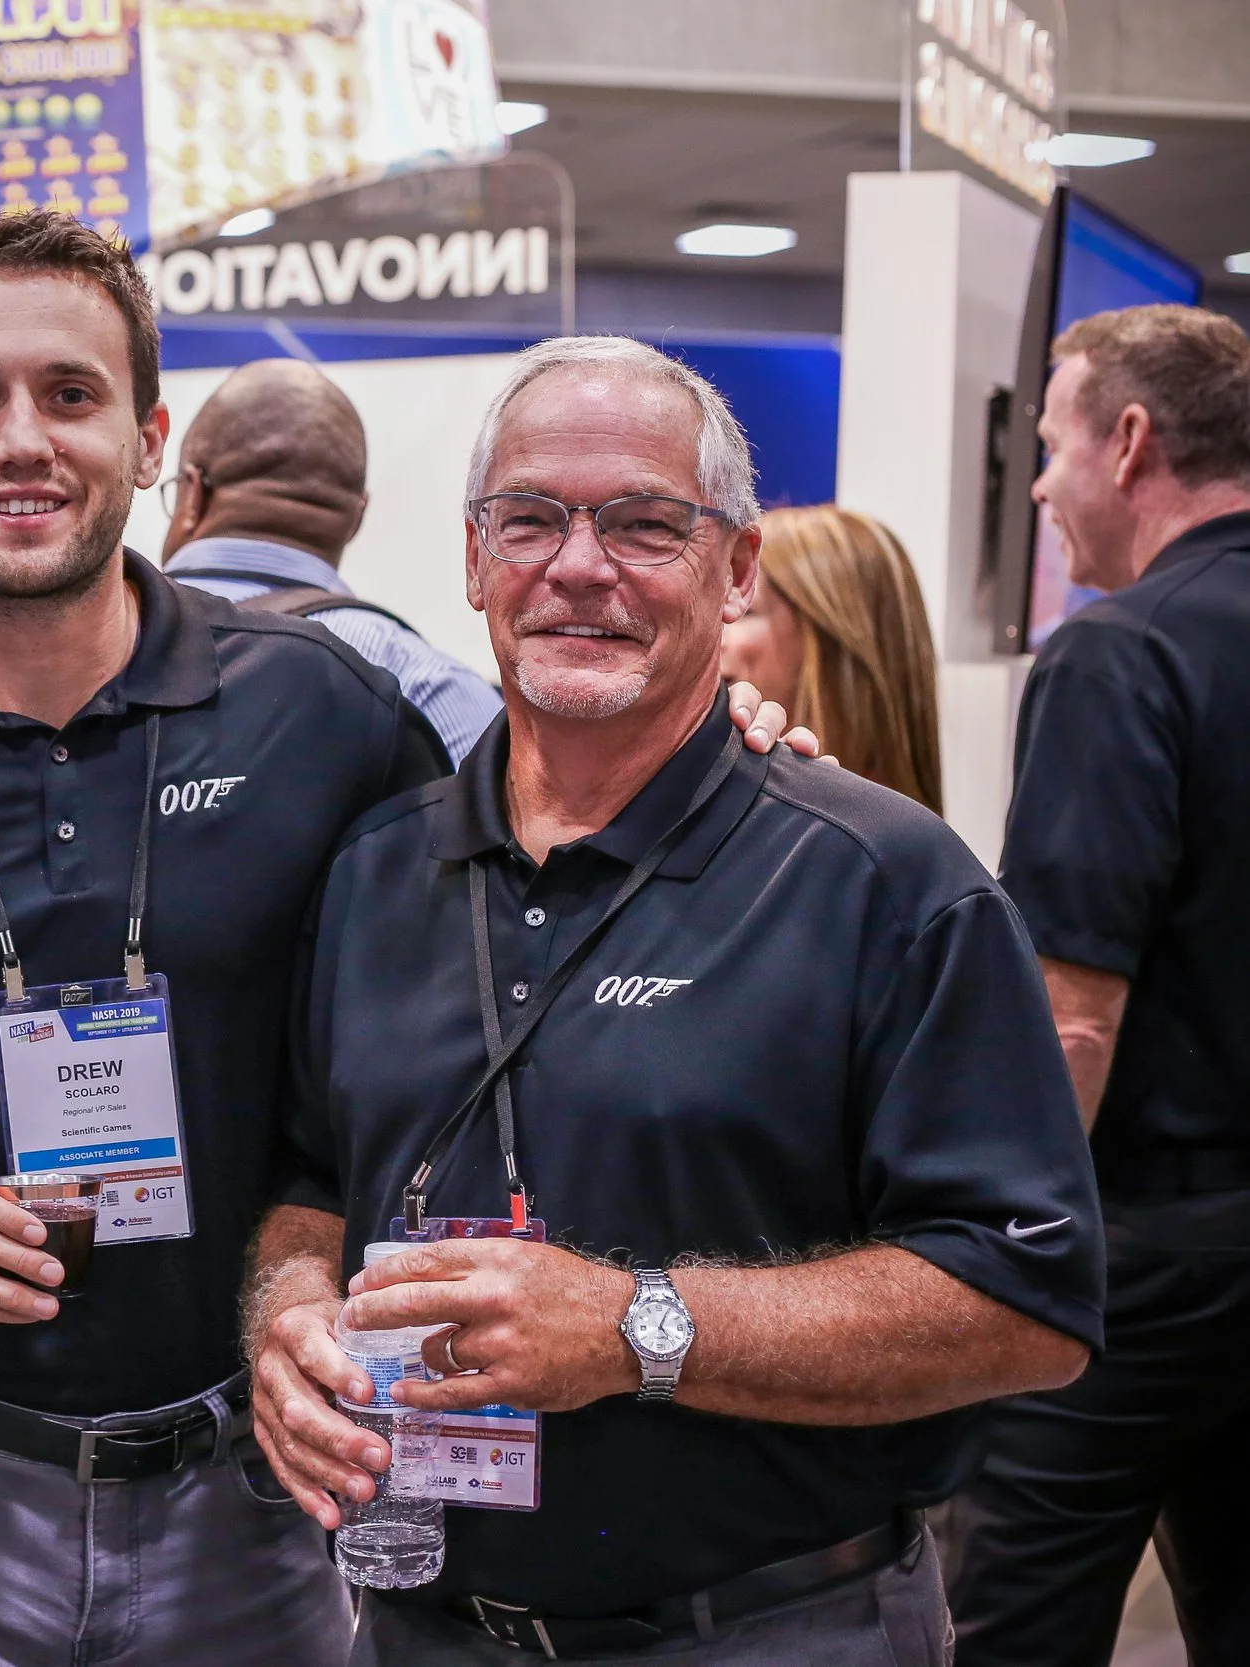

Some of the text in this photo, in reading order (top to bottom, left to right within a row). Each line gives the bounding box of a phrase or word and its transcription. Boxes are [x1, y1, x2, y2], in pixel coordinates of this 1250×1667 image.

[159, 777, 222, 816] 007
[63, 992, 83, 1003] 007
[594, 975, 668, 1006] 007
[92, 1007, 141, 1021] NASPL 2019
[10, 1022, 35, 1038] NASPL
[58, 1059, 123, 1083] DREW
[65, 1085, 120, 1099] SCOLARO
[63, 1103, 127, 1117] Regional VP Sales
[61, 1123, 132, 1137] Scientific Games
[59, 1147, 140, 1162] ASSOCIATE MEMBER
[152, 1186, 175, 1200] IGT
[450, 1446, 467, 1460] SG
[505, 1451, 526, 1466] IGT
